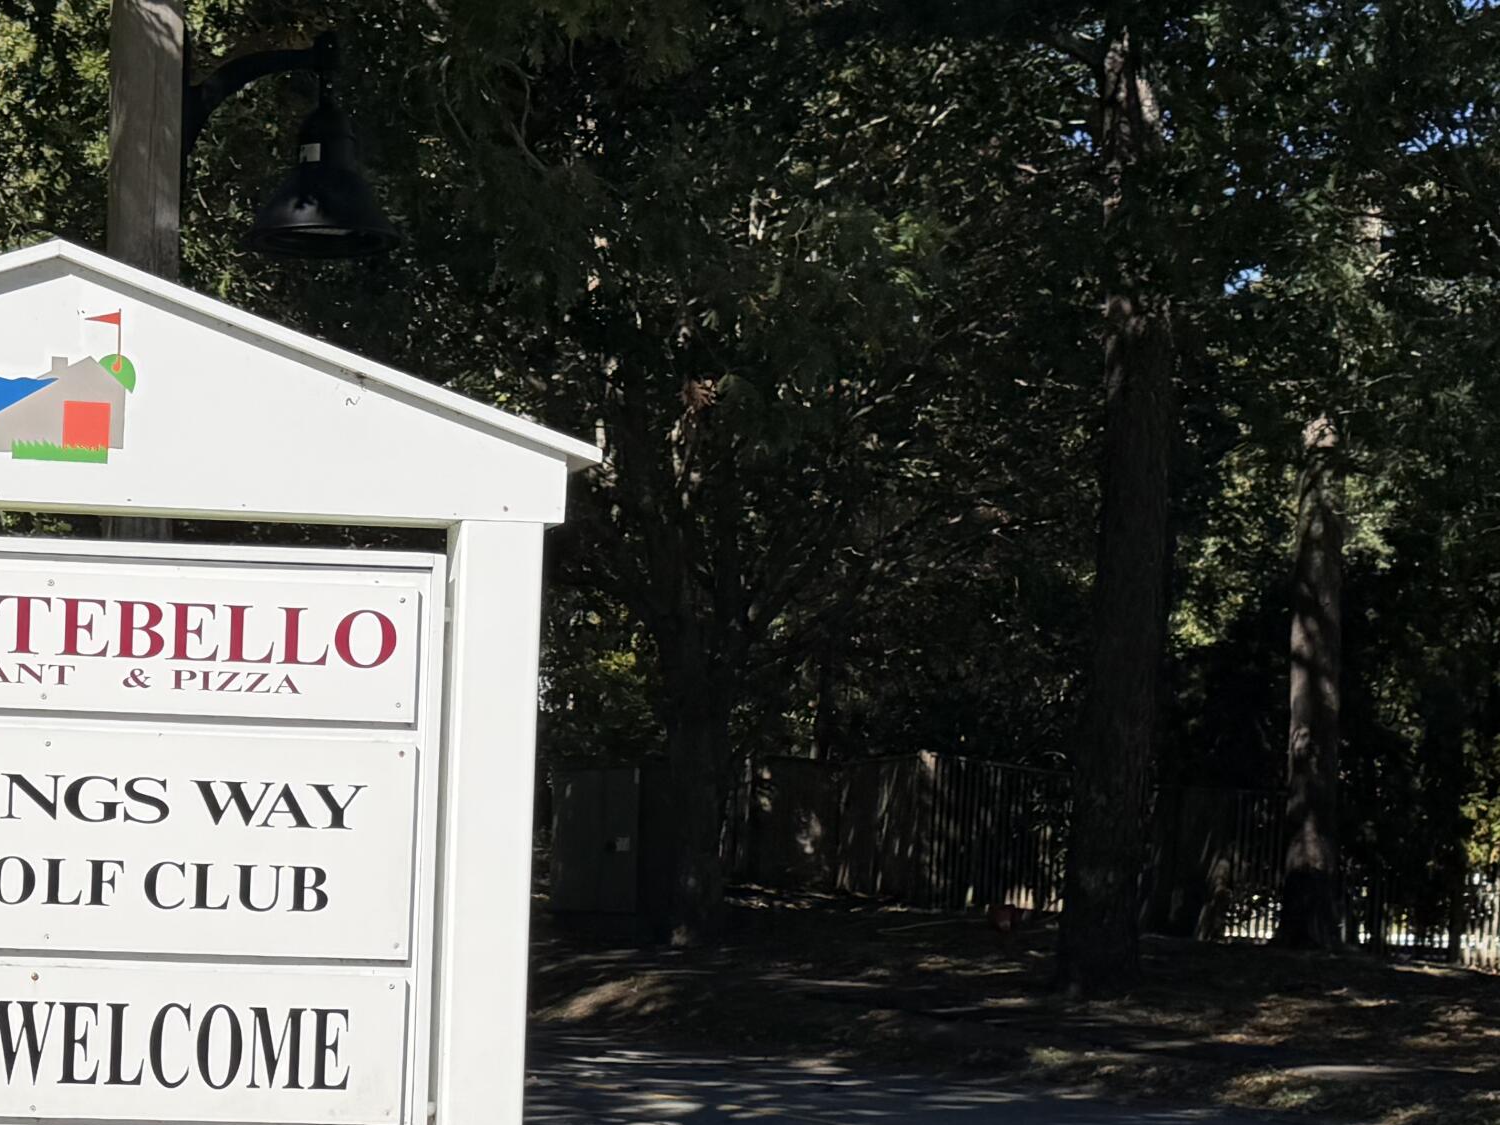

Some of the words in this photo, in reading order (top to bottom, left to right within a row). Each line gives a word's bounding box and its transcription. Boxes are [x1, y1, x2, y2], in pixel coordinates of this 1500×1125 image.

[121, 668, 151, 689] &
[171, 669, 302, 695] PIZZA
[191, 779, 368, 830] WAY
[143, 861, 330, 913] CLUB
